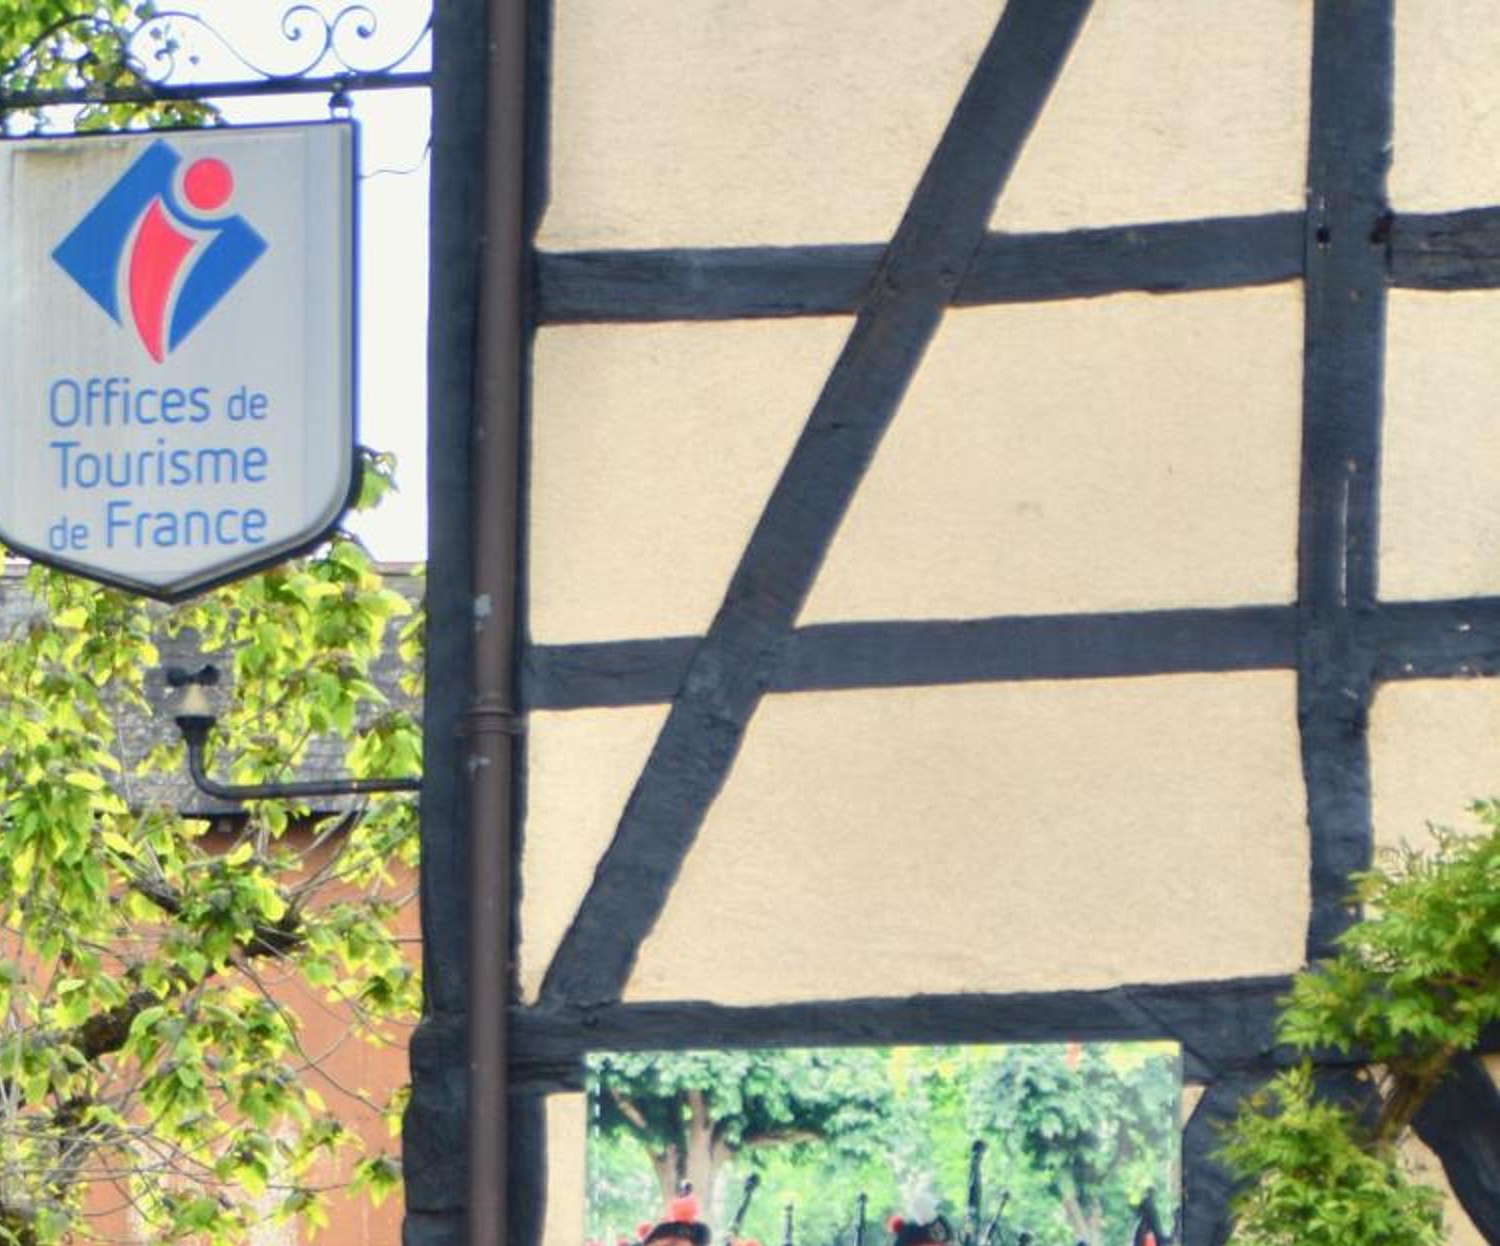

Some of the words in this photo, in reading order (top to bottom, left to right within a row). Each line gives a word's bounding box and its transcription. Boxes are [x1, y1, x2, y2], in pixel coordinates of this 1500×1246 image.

[49, 377, 211, 427] Offices
[227, 385, 269, 421] de
[50, 437, 268, 490] Tourisme
[49, 515, 90, 552] de
[106, 500, 268, 549] France
